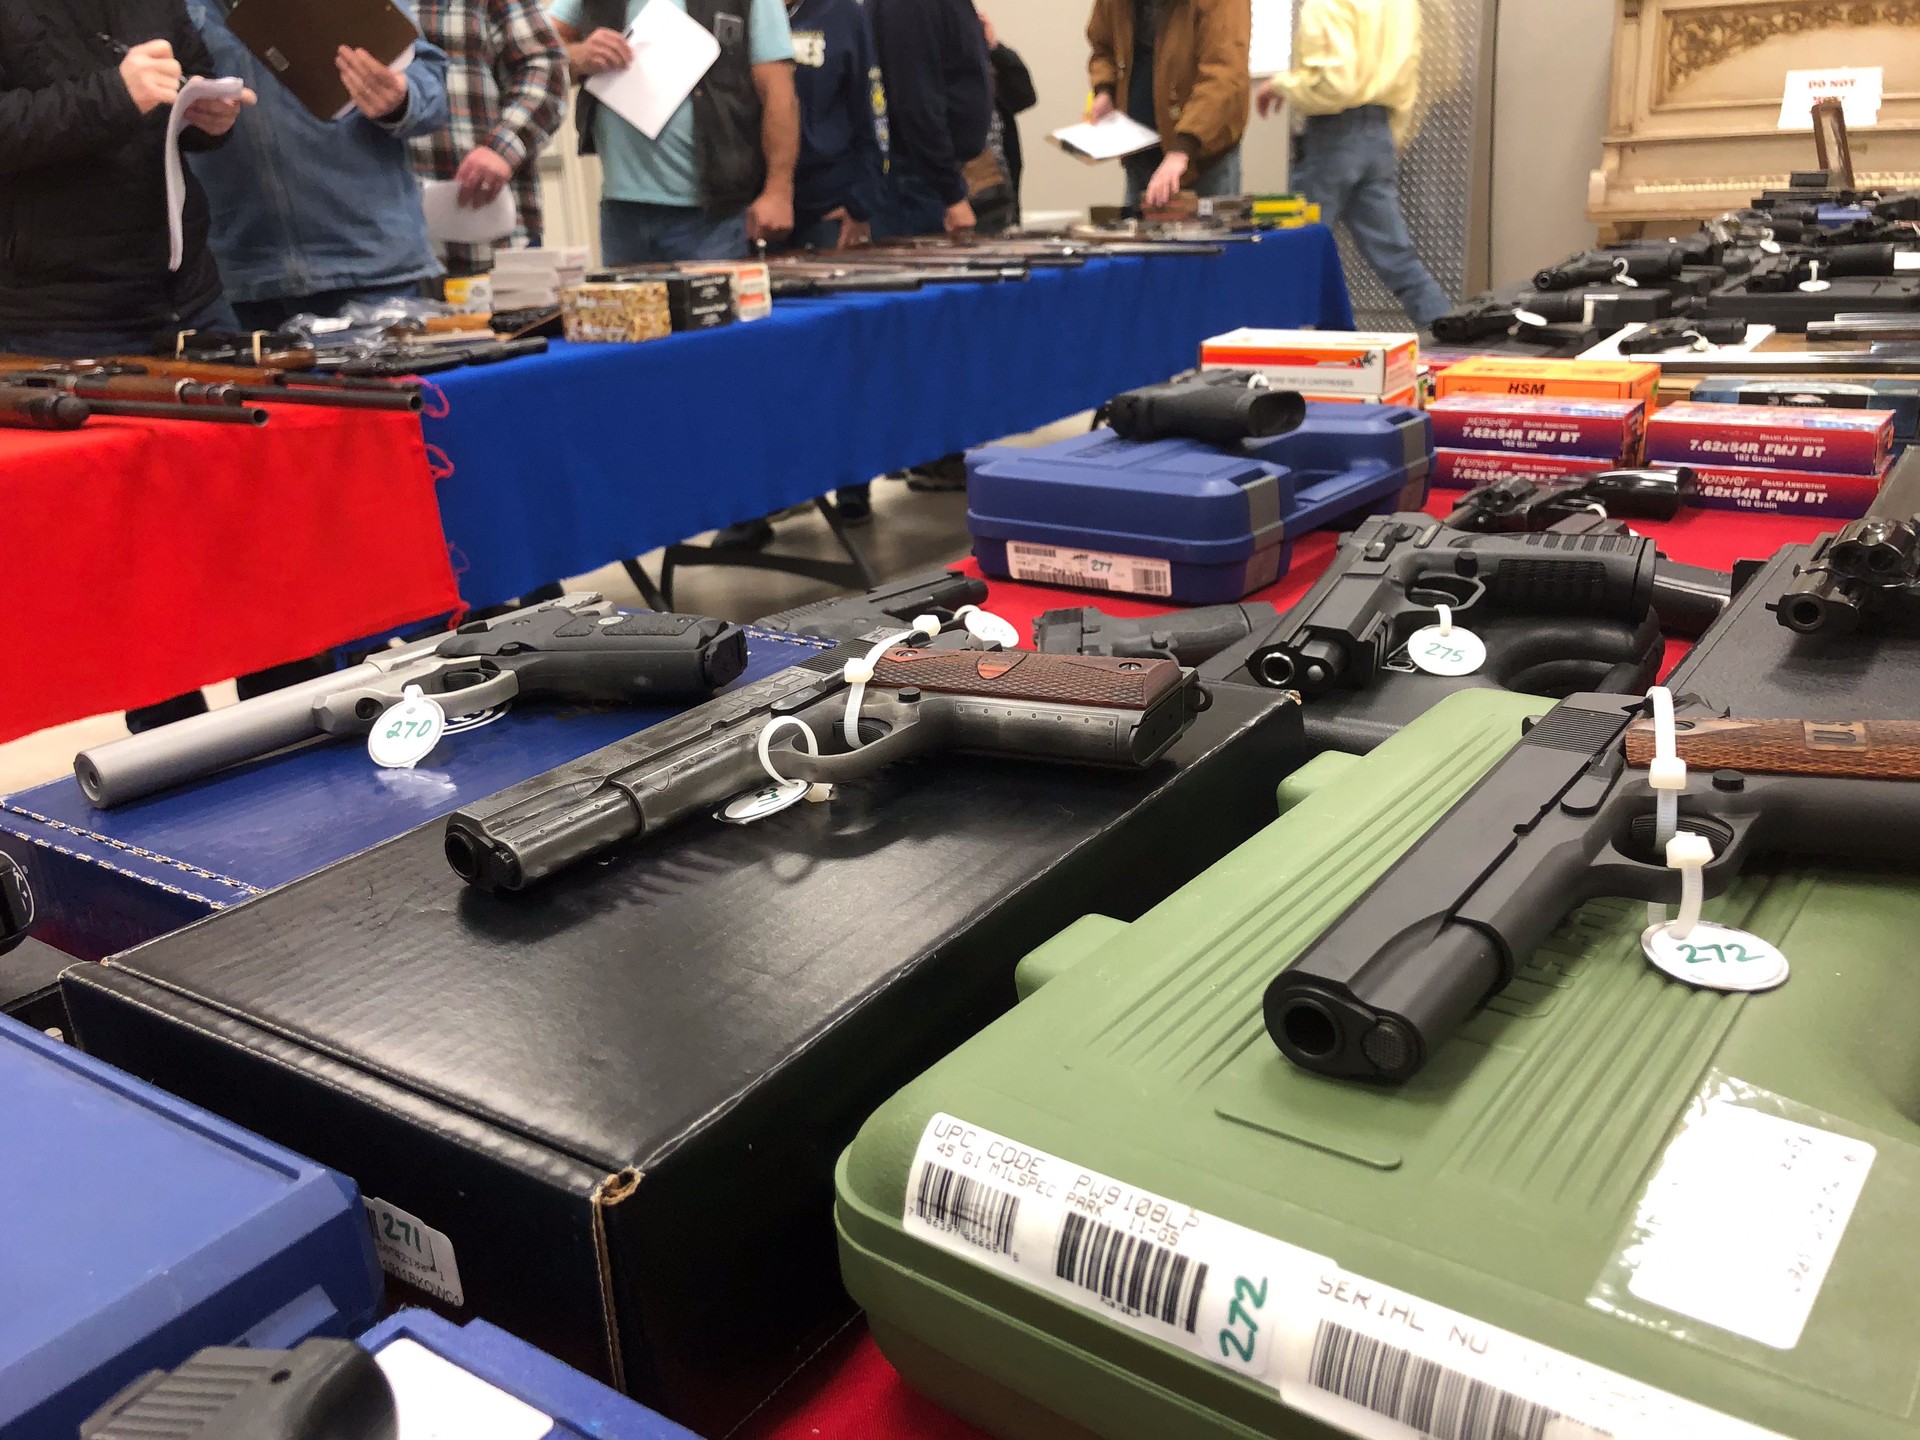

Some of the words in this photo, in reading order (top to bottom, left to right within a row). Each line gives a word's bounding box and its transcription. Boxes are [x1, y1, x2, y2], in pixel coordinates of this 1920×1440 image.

[1507, 383, 1545, 396] HSM
[1462, 426, 1523, 440] 7.62x54R
[1527, 429, 1557, 442] FMJ
[1560, 431, 1581, 443] BT
[1690, 439, 1759, 454] 7.62x54R
[1764, 443, 1798, 457] FMJ
[1802, 445, 1827, 458] BT
[1752, 454, 1776, 464] Grain
[1697, 484, 1761, 500] .62x54R
[1766, 489, 1799, 503] FMJ
[1804, 491, 1828, 505] BT
[1754, 499, 1778, 510] Grain
[1425, 642, 1466, 663] 275
[386, 719, 432, 739] 270
[1675, 943, 1765, 964] 272
[933, 1118, 978, 1150] UPC
[986, 1140, 1047, 1177] CODE
[936, 1142, 956, 1159] 45
[962, 1150, 982, 1169] GI
[991, 1162, 1058, 1199] MILSPEC
[382, 1211, 422, 1254] 271
[1219, 1274, 1269, 1364] 272
